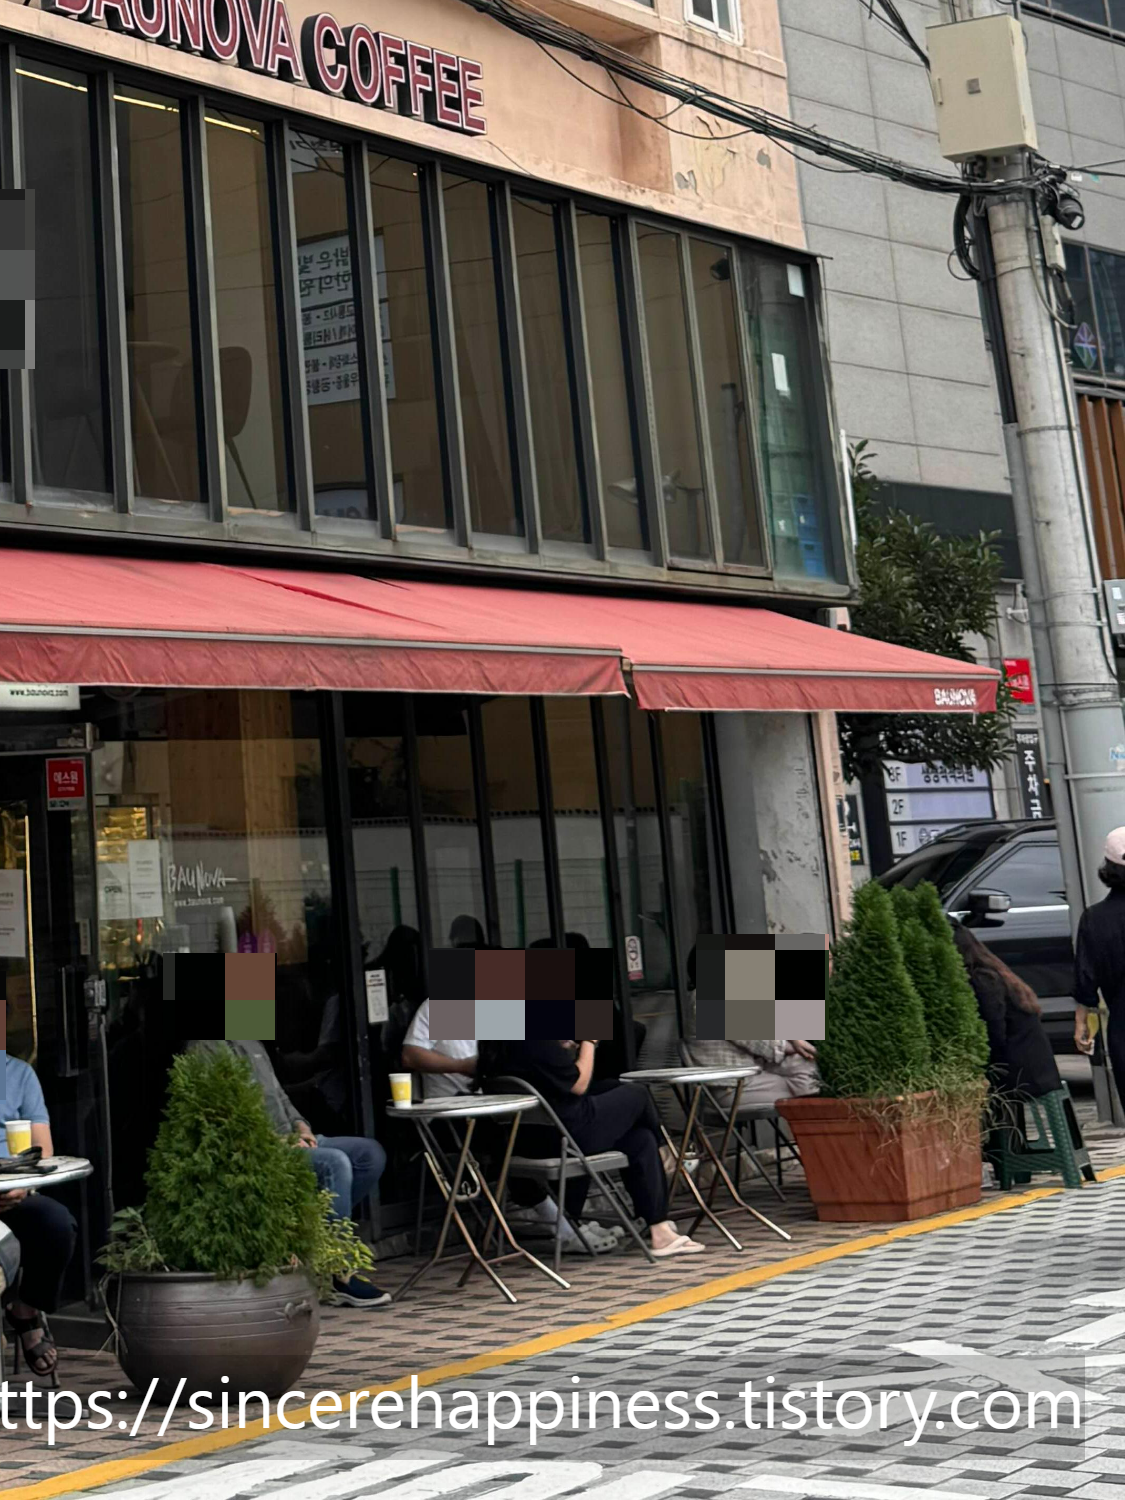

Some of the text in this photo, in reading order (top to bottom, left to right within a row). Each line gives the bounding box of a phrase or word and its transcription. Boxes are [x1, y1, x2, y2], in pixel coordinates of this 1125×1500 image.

[305, 12, 487, 136] COFFEE
[891, 798, 904, 816] 2F
[895, 830, 908, 847] 1F
